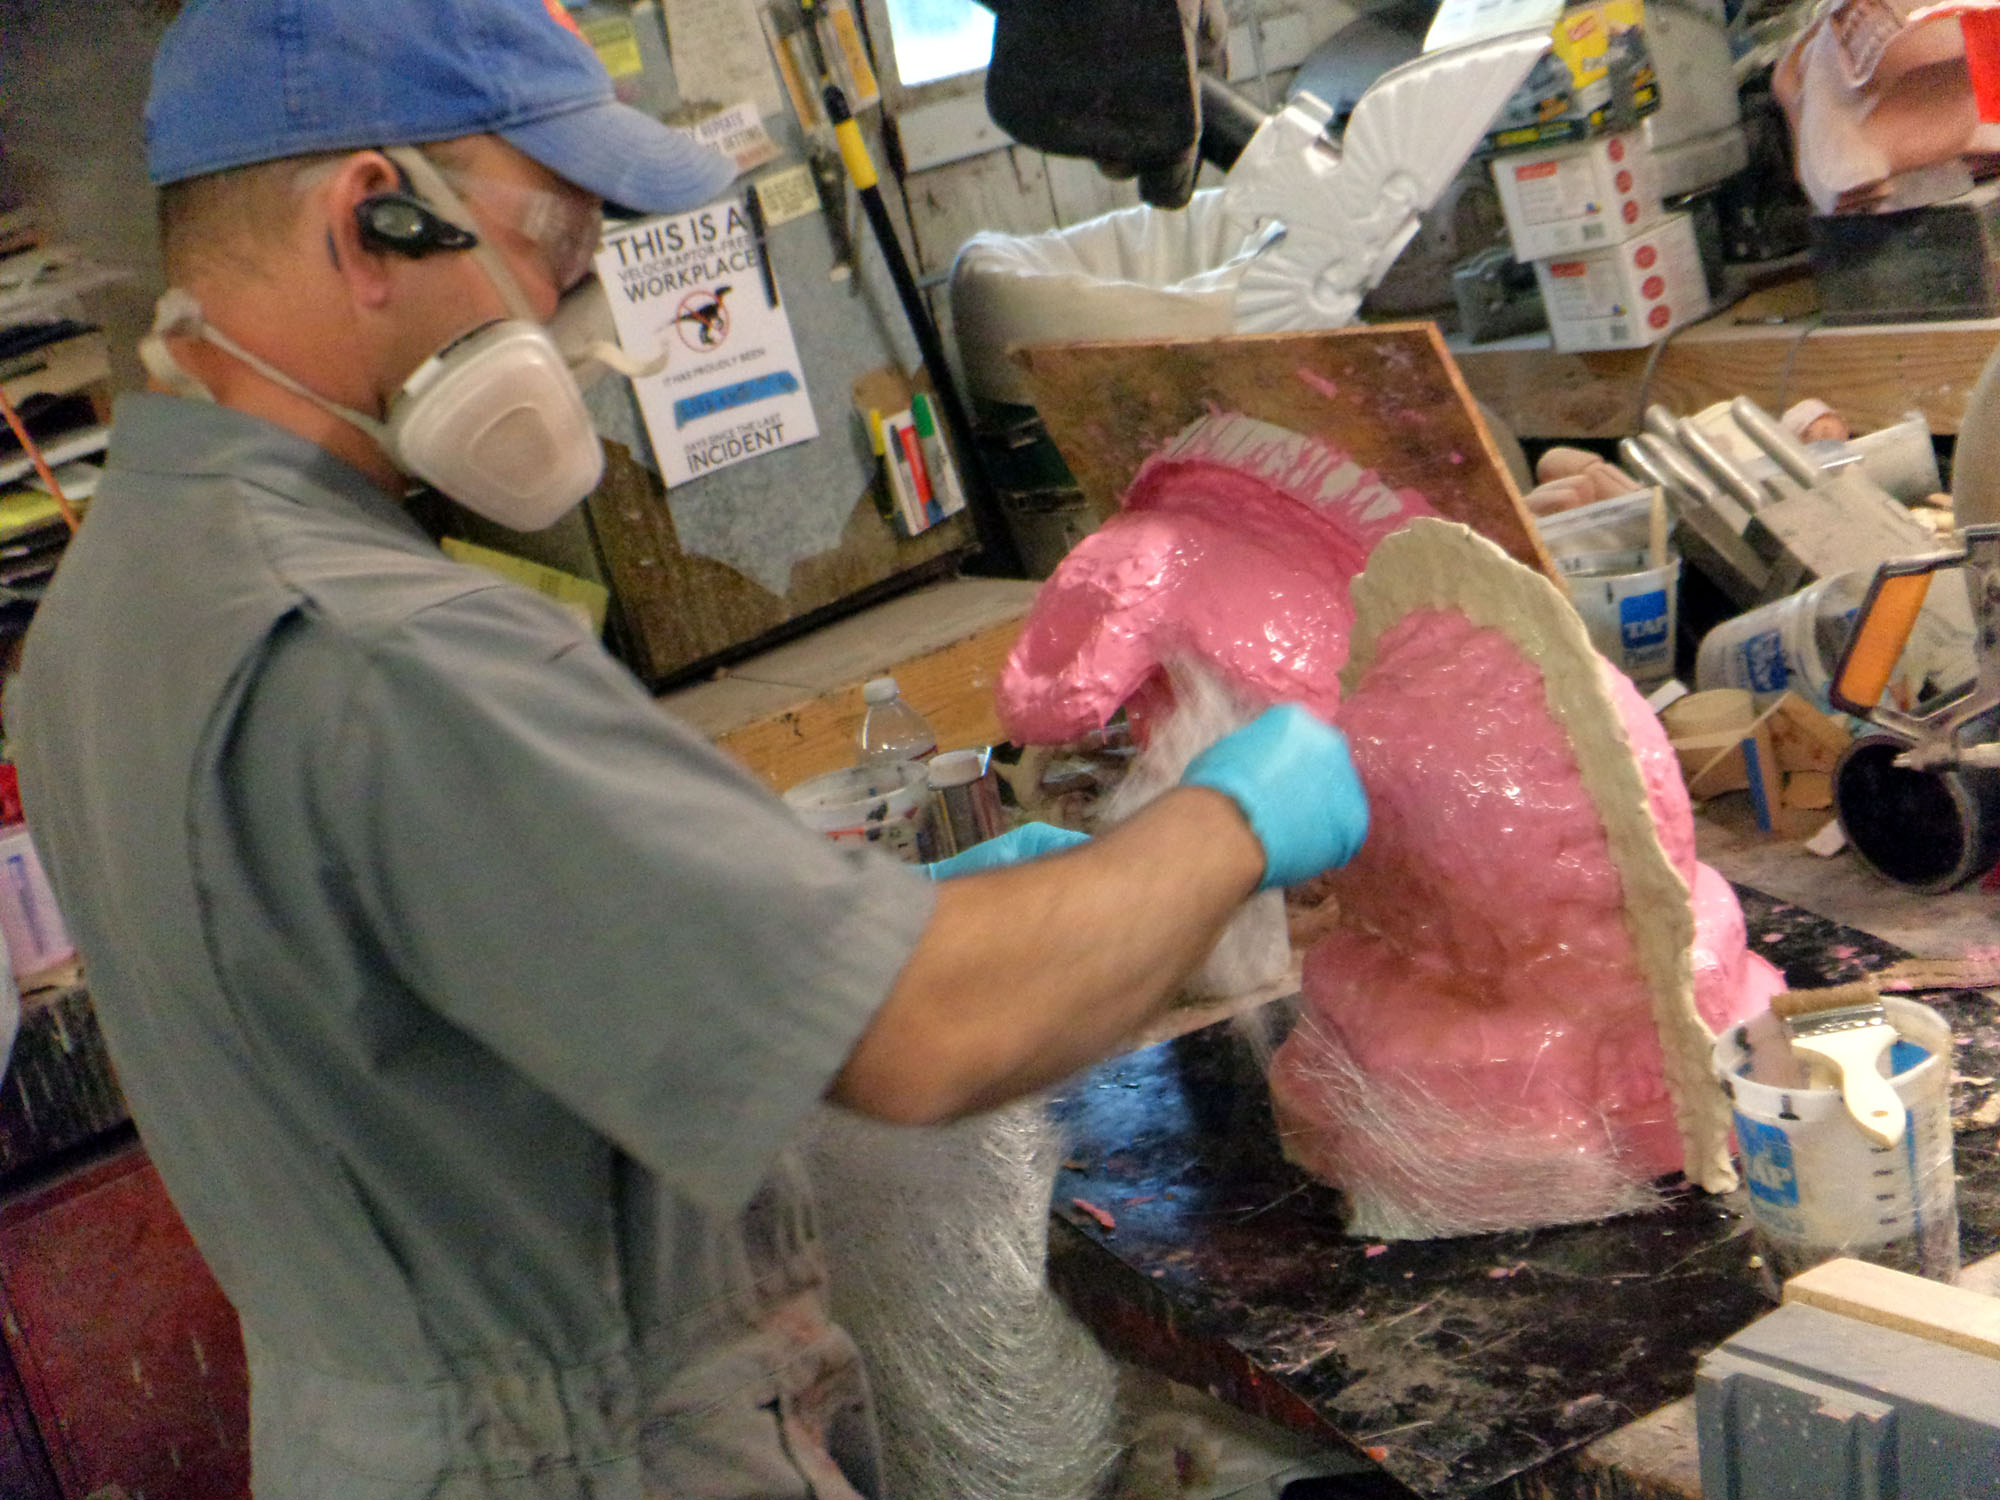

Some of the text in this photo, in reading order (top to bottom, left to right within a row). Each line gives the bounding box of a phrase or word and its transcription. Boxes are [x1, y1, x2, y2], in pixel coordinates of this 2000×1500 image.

[609, 206, 749, 266] THIS IS A
[624, 249, 758, 304] WORKPLACE
[686, 422, 784, 474] INCIDENT
